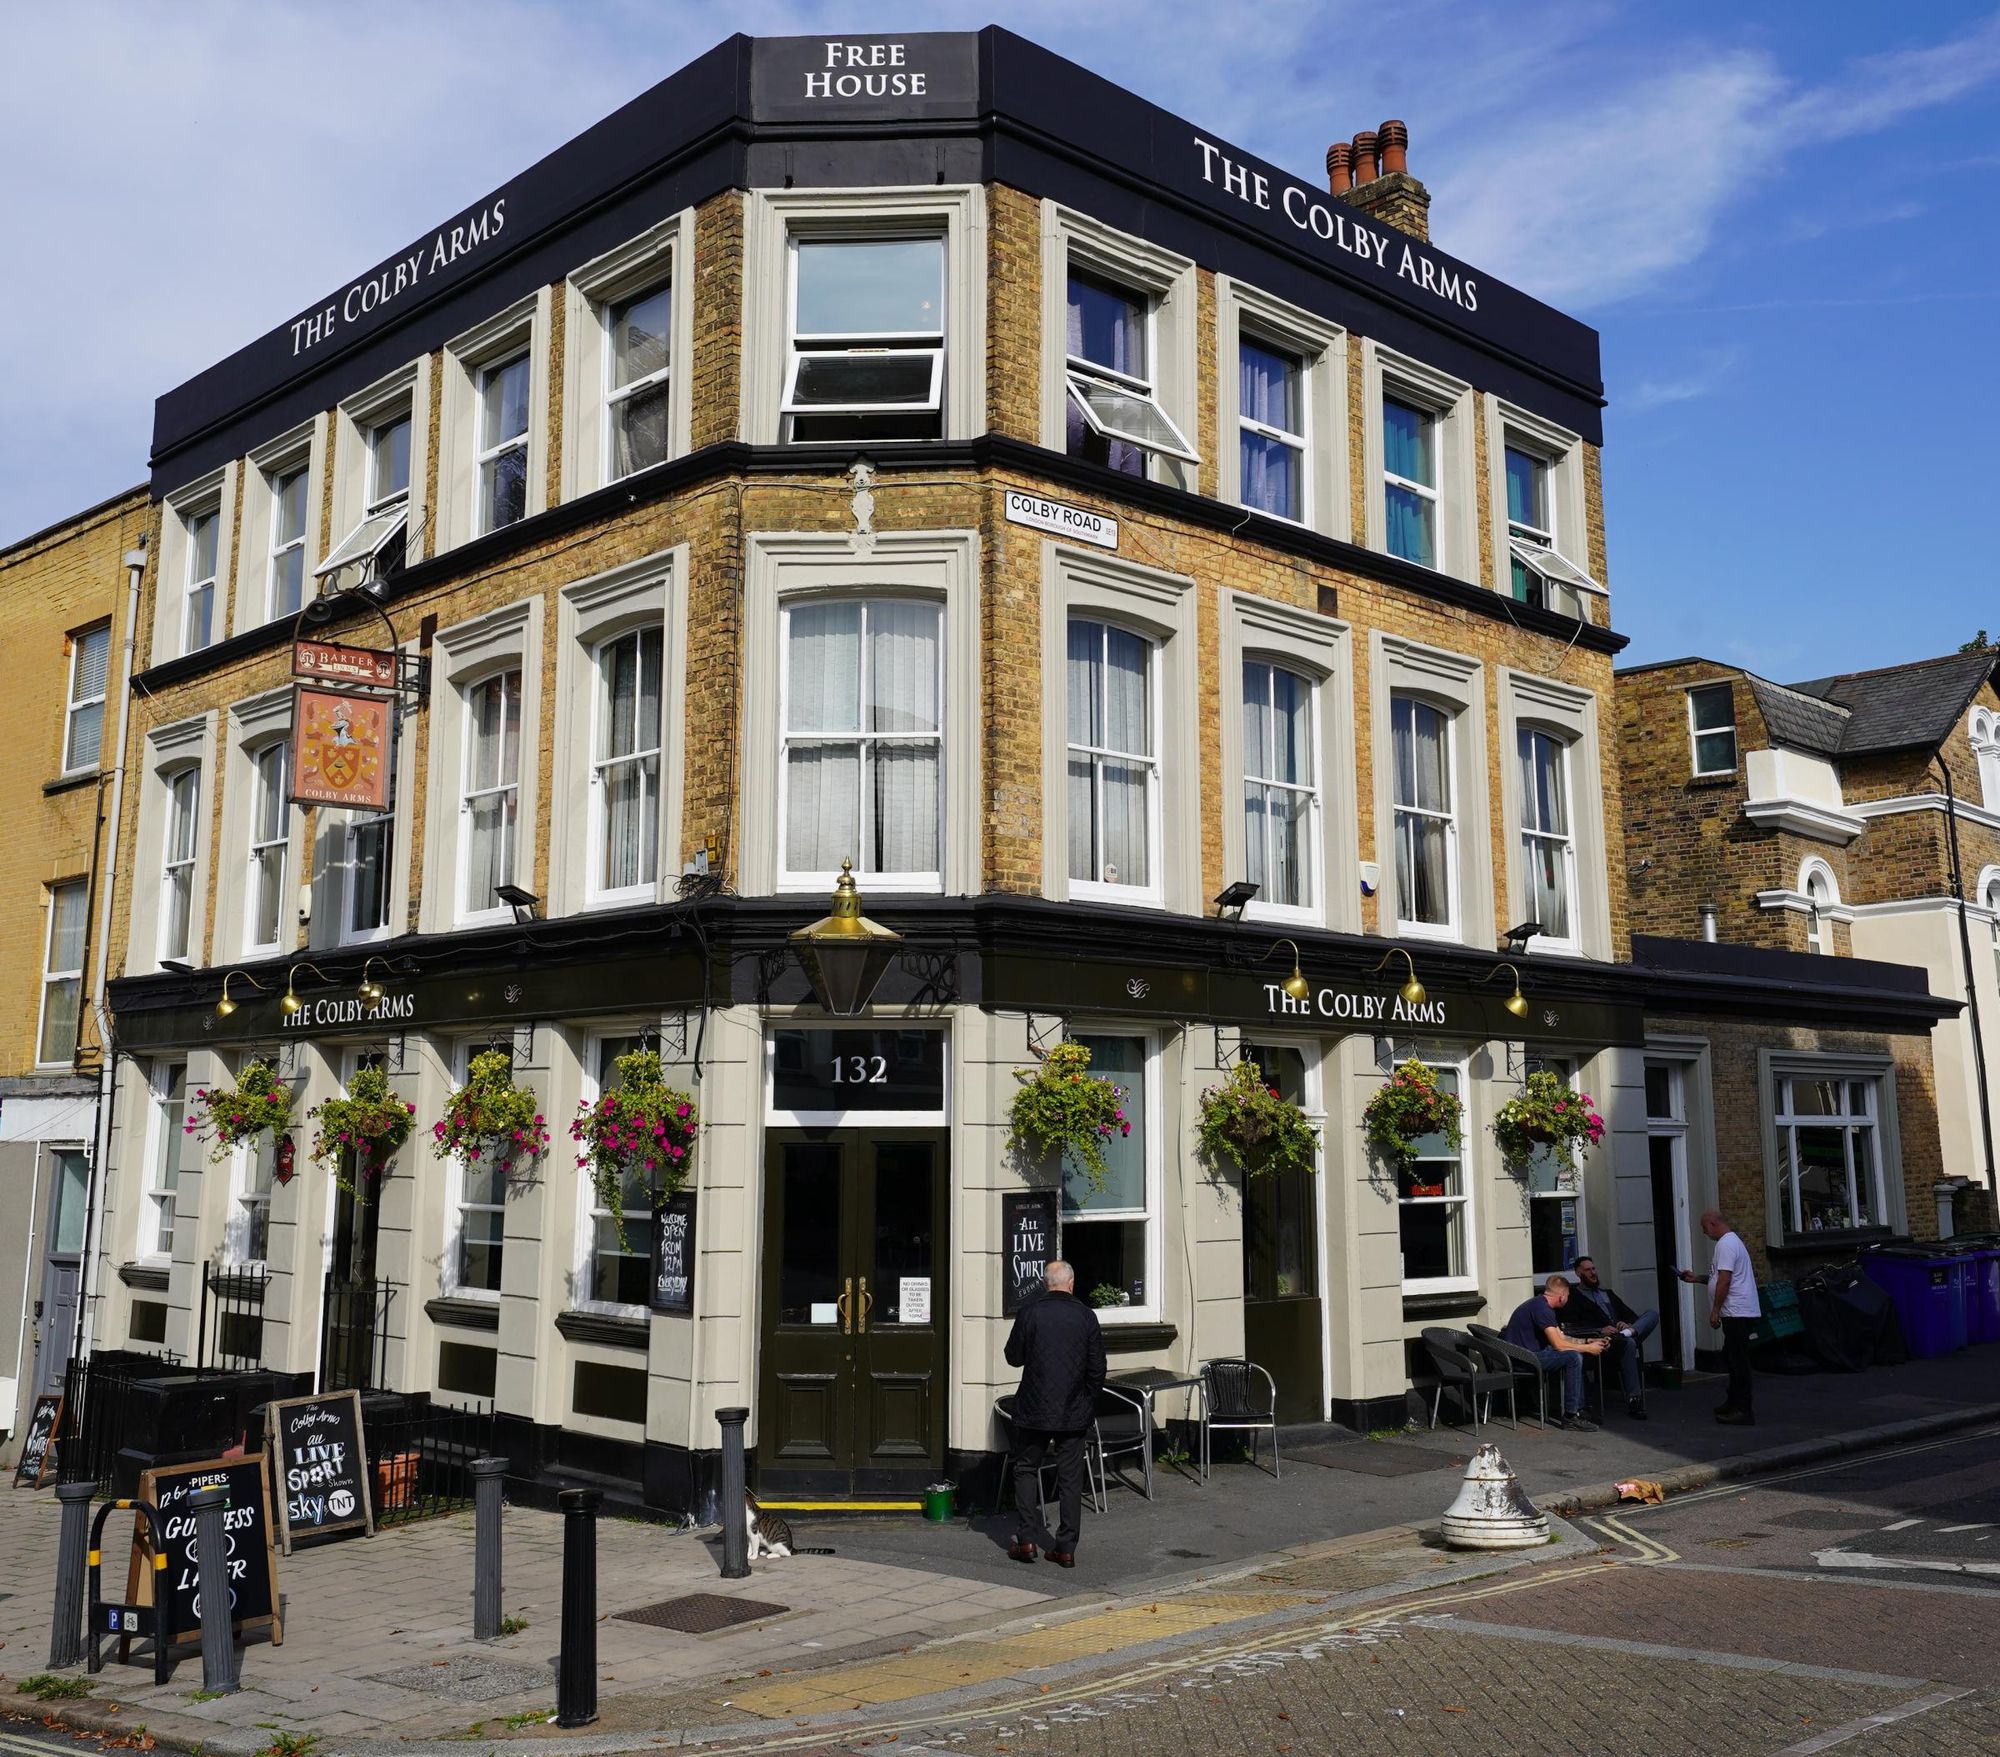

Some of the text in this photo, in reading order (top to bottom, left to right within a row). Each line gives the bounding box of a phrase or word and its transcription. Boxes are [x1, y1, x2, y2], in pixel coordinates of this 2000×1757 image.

[825, 42, 906, 68] FREE
[804, 72, 927, 98] HOUSE
[1194, 136, 1478, 312] THE COLBY ARMS
[291, 199, 505, 356] THE COLBY ARMS
[1011, 495, 1059, 520] COLBY
[1063, 509, 1102, 532] ROAD
[320, 652, 373, 667] BARTER
[305, 788, 371, 803] COLBY ARMS
[316, 999, 363, 1025] COLBY
[368, 994, 414, 1020] ARMS
[1318, 988, 1387, 1019] COLBY
[1391, 994, 1445, 1024] ARMS
[830, 1056, 888, 1083] 132
[663, 1224, 687, 1240] OPEN
[1013, 1233, 1045, 1253] LIVE
[661, 1239, 683, 1256] FROM
[1012, 1254, 1046, 1288] SPORT
[290, 1410, 340, 1434] Colby Arms
[293, 1441, 346, 1465] LIVE
[288, 1492, 324, 1525] sky
[329, 1495, 354, 1512] TNT
[111, 1612, 118, 1627] P
